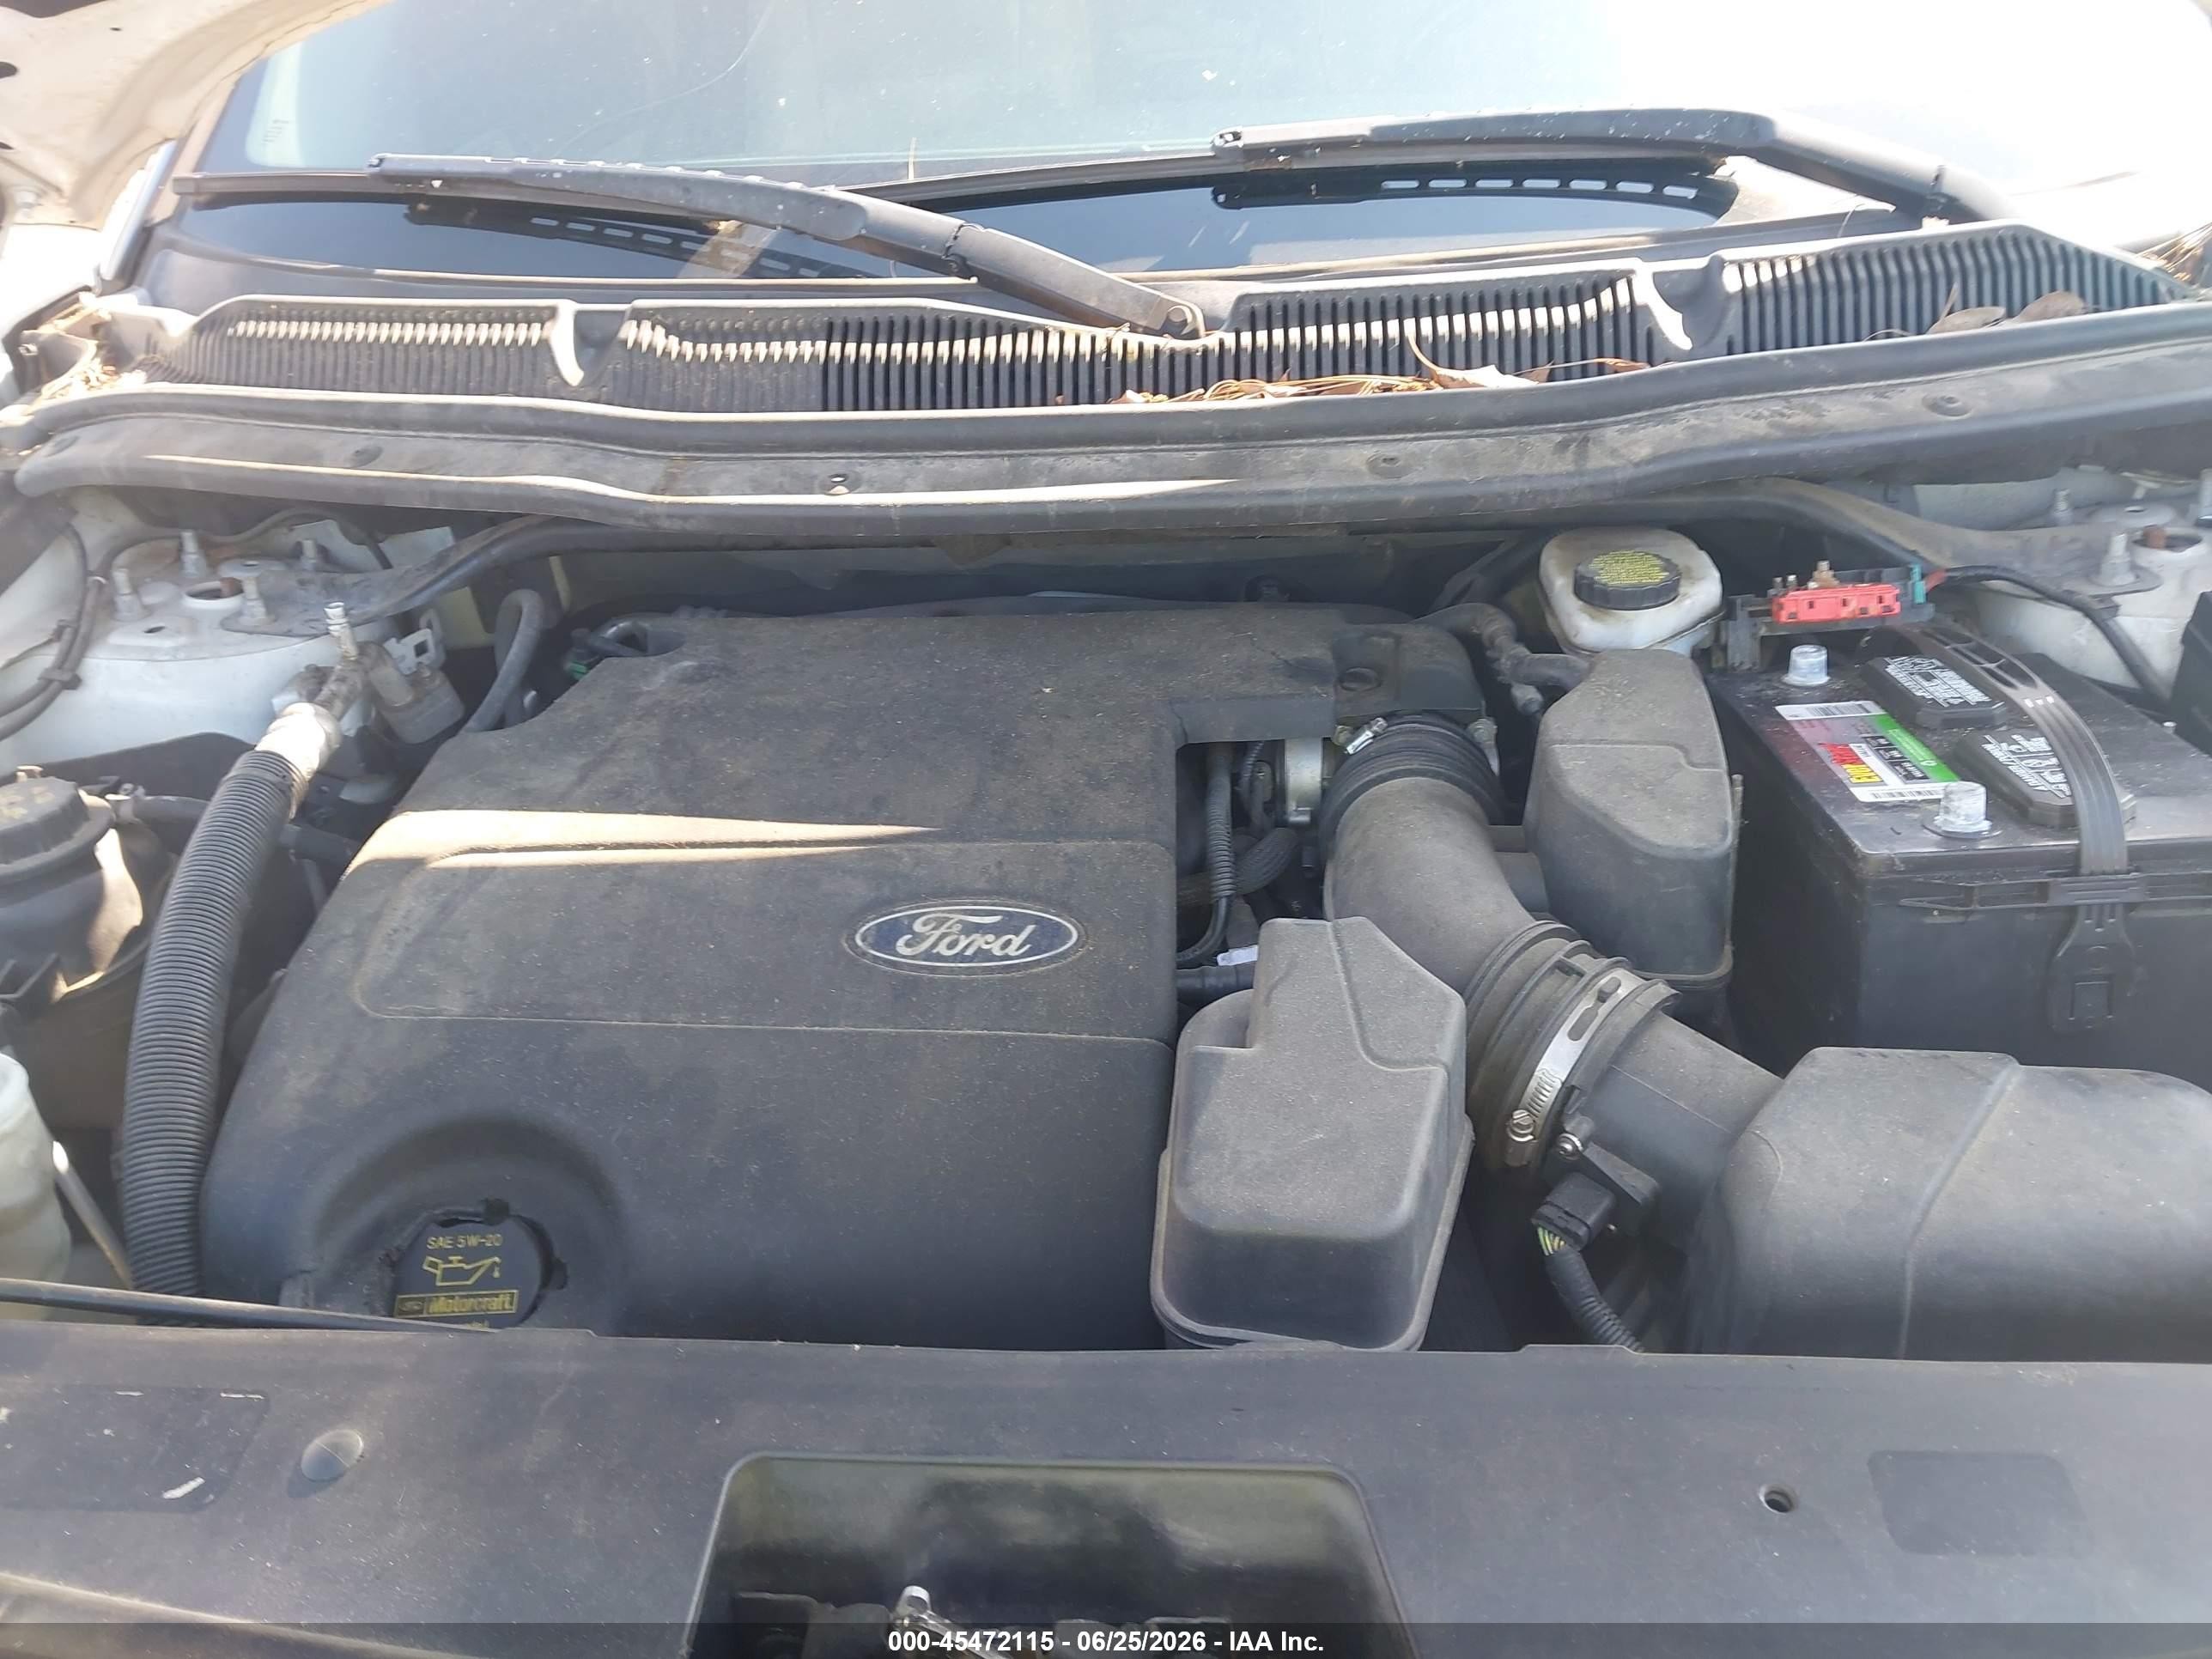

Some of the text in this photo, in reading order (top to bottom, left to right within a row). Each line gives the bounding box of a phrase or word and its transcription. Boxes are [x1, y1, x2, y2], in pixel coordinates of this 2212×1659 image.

[895, 913, 1036, 957] Ford
[426, 1233, 504, 1249] SAE 5W-20
[428, 1293, 513, 1314] Motorcraft
